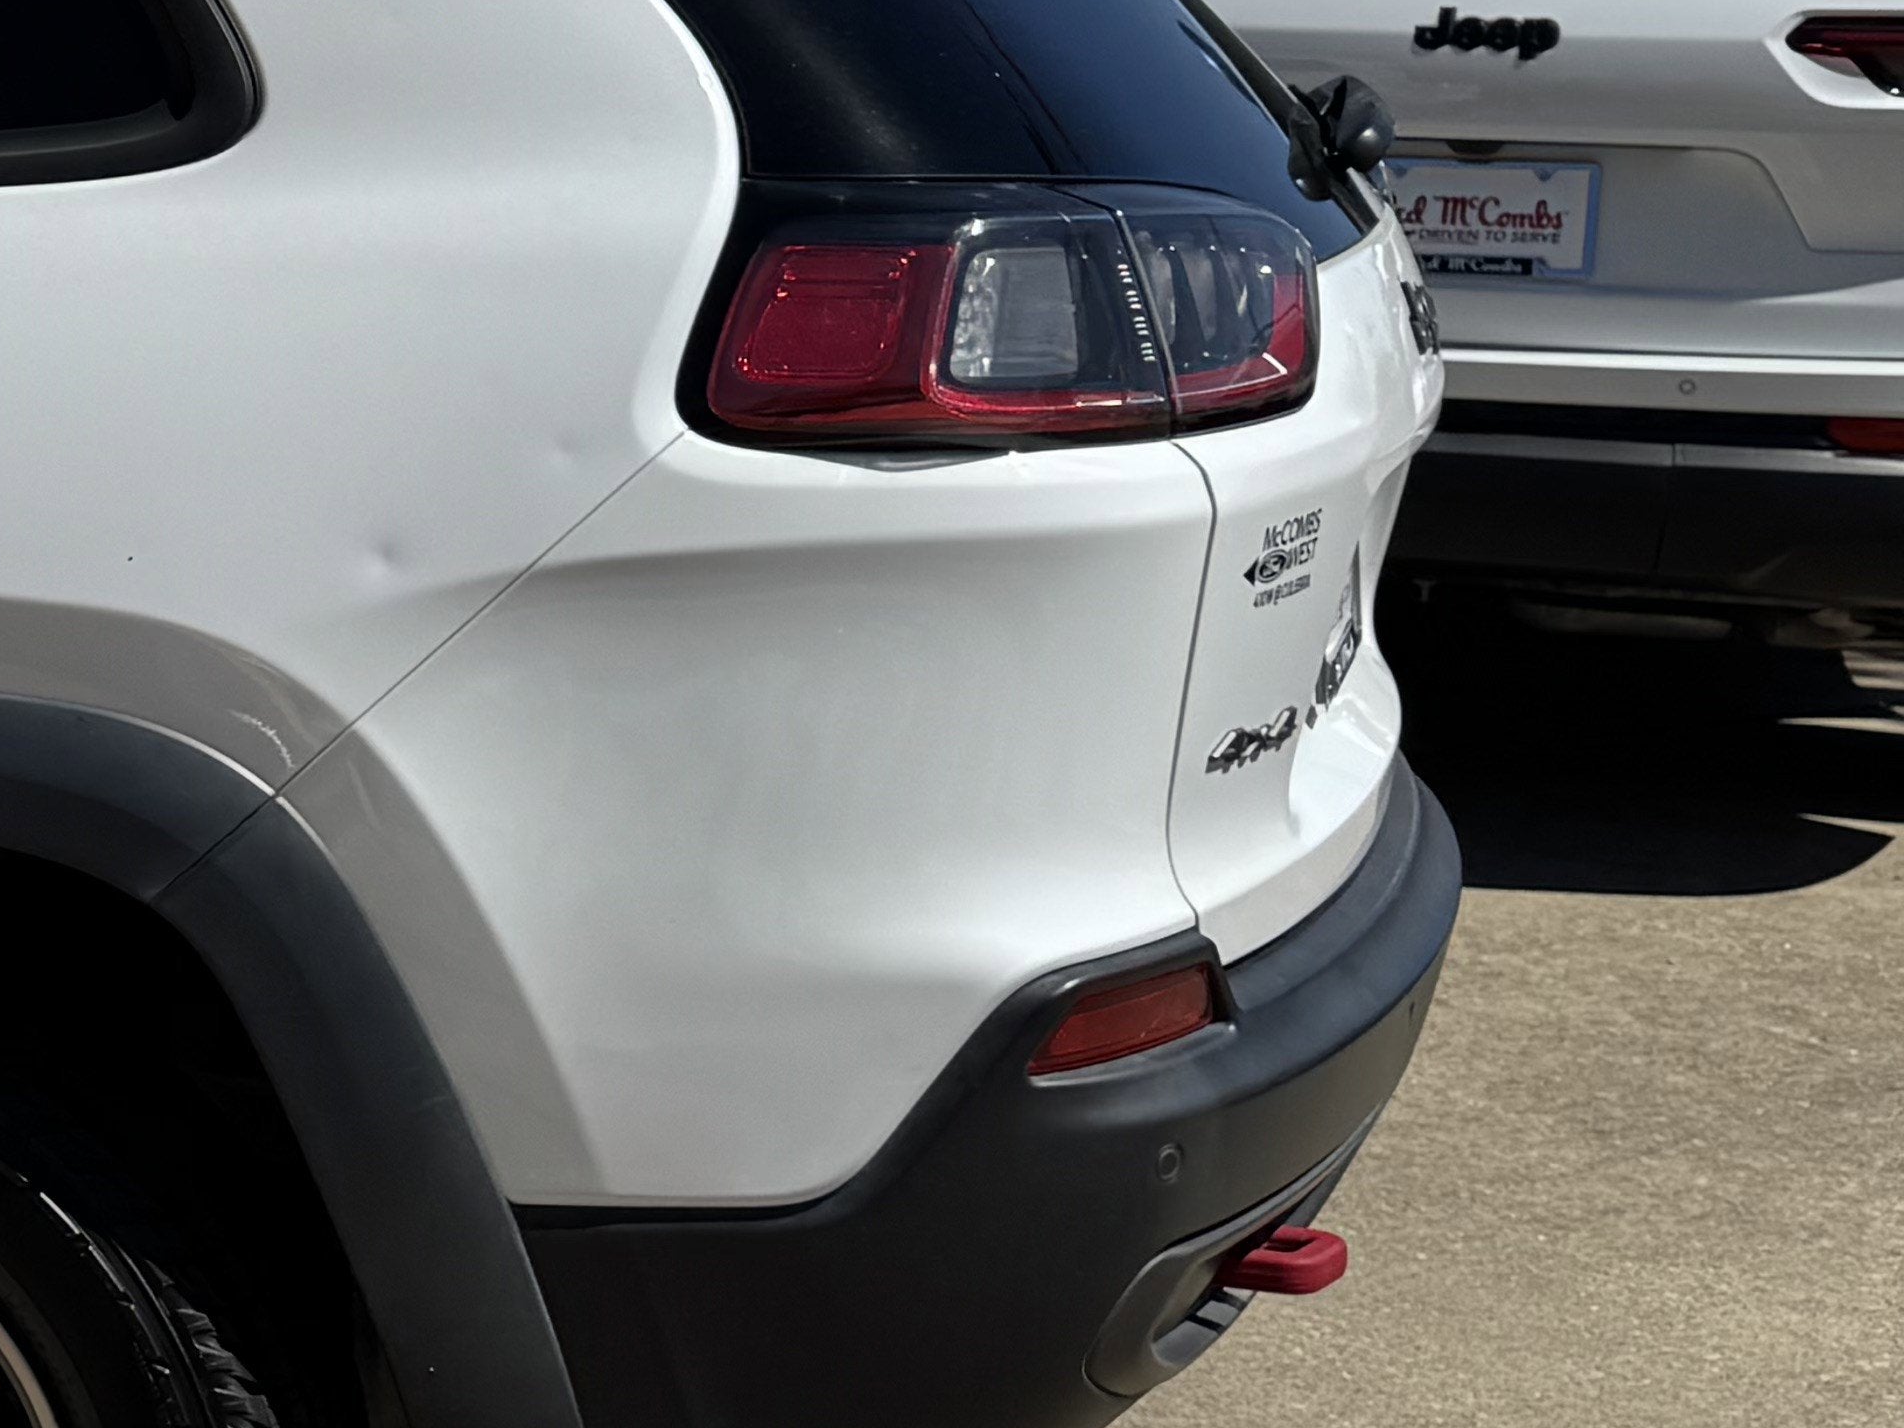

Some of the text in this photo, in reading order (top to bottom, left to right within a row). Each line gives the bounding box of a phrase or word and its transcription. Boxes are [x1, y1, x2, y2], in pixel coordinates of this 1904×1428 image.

[1413, 5, 1560, 61] Jeep
[1433, 196, 1564, 231] McCombs
[1419, 228, 1561, 245] DRIVEN TO SERVE
